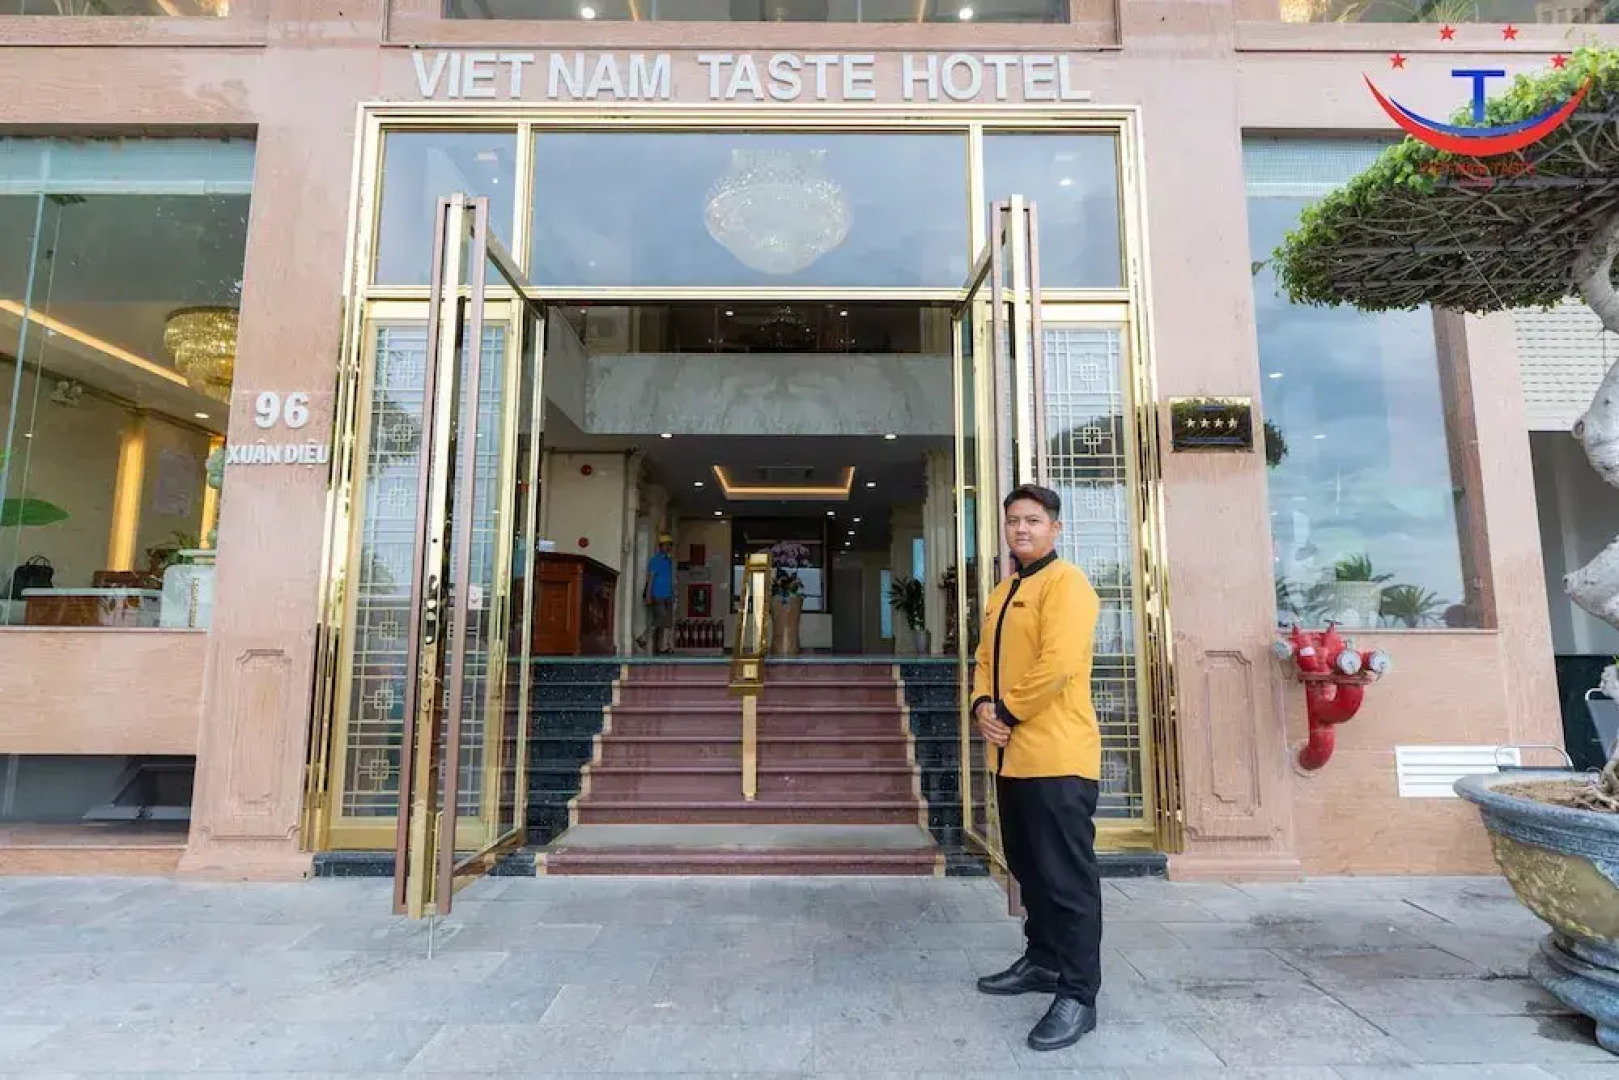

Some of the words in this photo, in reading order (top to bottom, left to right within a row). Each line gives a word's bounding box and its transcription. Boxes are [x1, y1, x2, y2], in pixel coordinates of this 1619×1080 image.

[412, 52, 534, 99] VIET
[547, 52, 671, 100] NAM
[698, 53, 876, 101] TASTE
[903, 53, 1091, 101] HOTEL
[255, 391, 309, 429] 96
[227, 439, 281, 465] XUÂN
[284, 439, 329, 469] DIỆU
